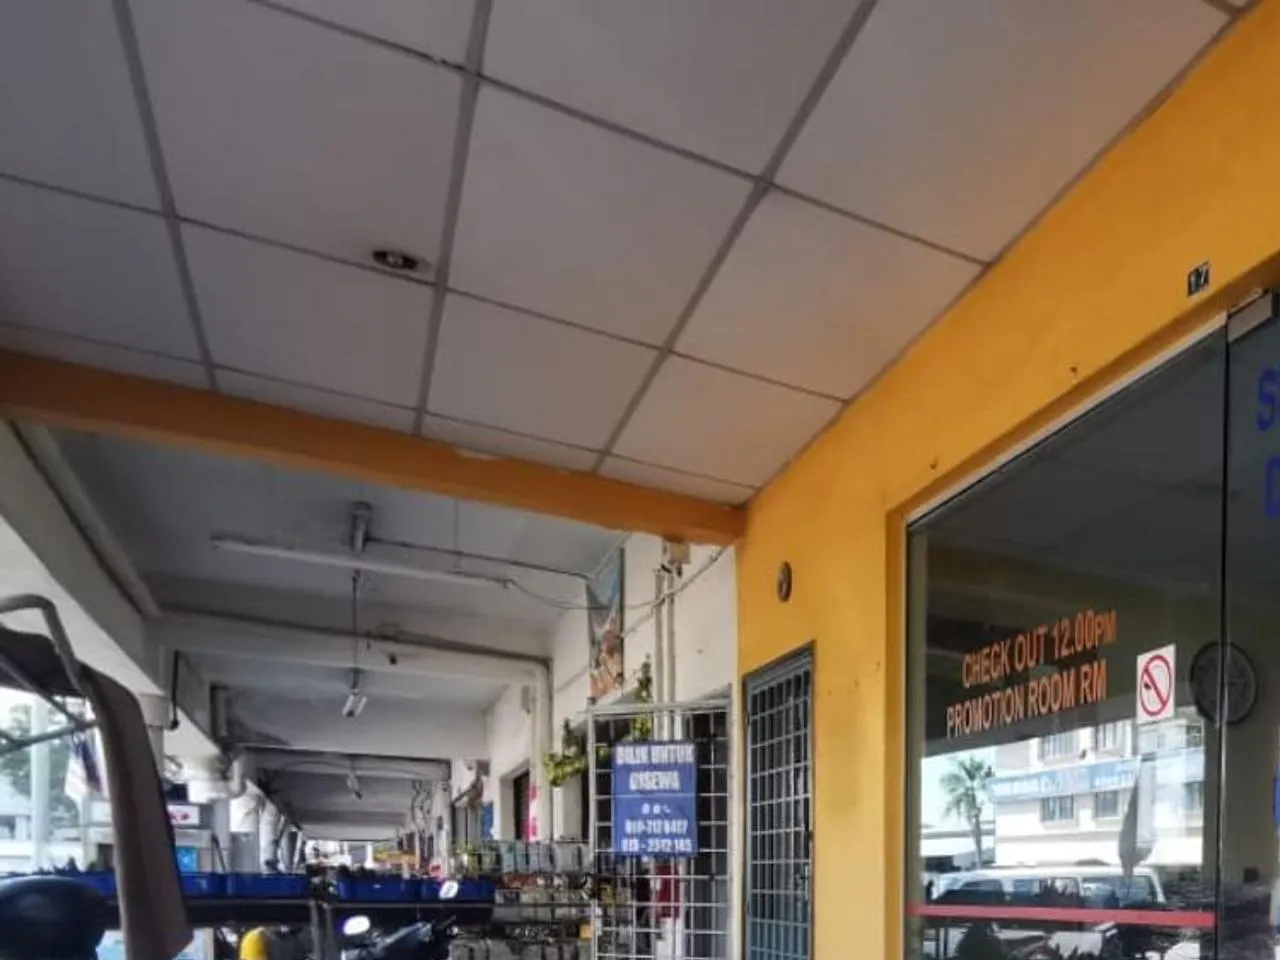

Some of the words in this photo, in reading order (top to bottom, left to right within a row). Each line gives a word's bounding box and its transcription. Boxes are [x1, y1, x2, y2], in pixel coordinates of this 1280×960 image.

[962, 641, 1010, 689] CHECK
[1014, 624, 1050, 672] OUT
[1052, 609, 1118, 660] 12.00PM
[946, 687, 1025, 739] PROMOTION
[1027, 671, 1075, 717] ROOM
[1079, 658, 1108, 706] RM
